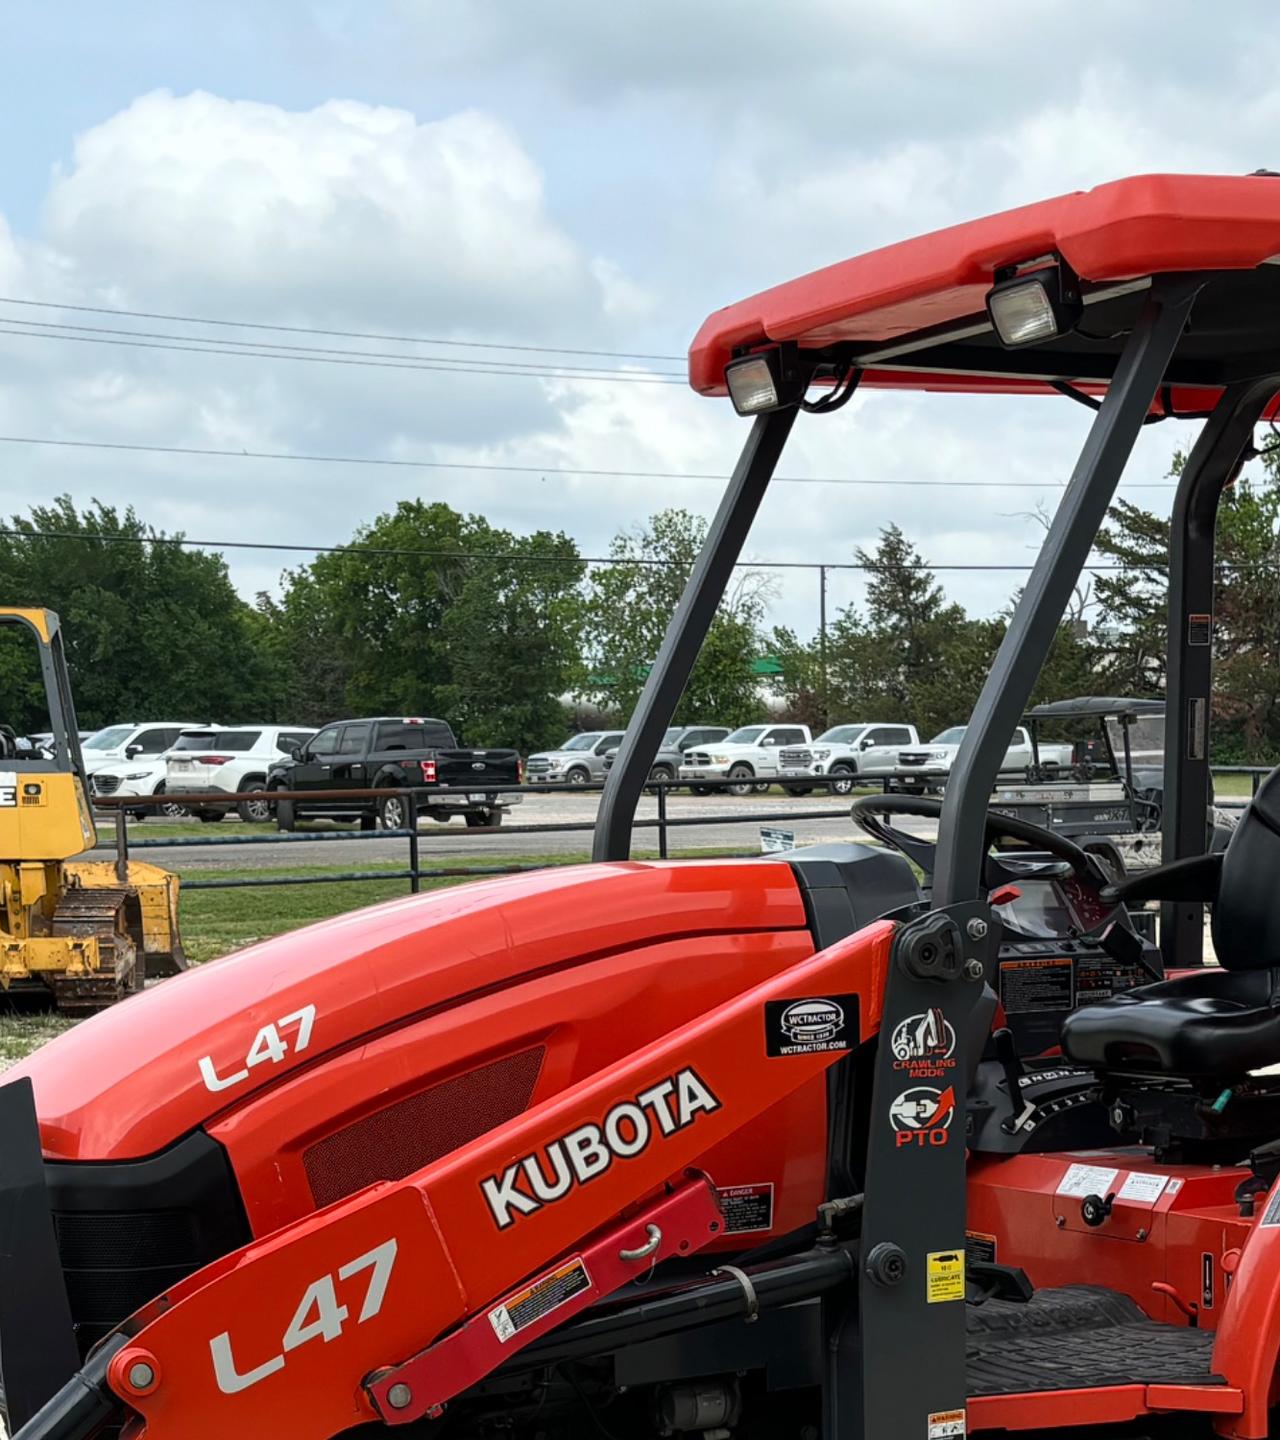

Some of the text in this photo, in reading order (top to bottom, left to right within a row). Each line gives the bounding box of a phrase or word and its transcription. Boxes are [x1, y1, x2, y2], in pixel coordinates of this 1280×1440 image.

[788, 1012, 838, 1025] WCTRACTOR
[197, 1003, 317, 1092] L47
[780, 1040, 847, 1055] WCTRACTOR.COM
[892, 1058, 956, 1071] CRAWLING
[477, 1065, 723, 1231] KUBOTA
[895, 1128, 949, 1148] PTO
[209, 1237, 398, 1395] L47
